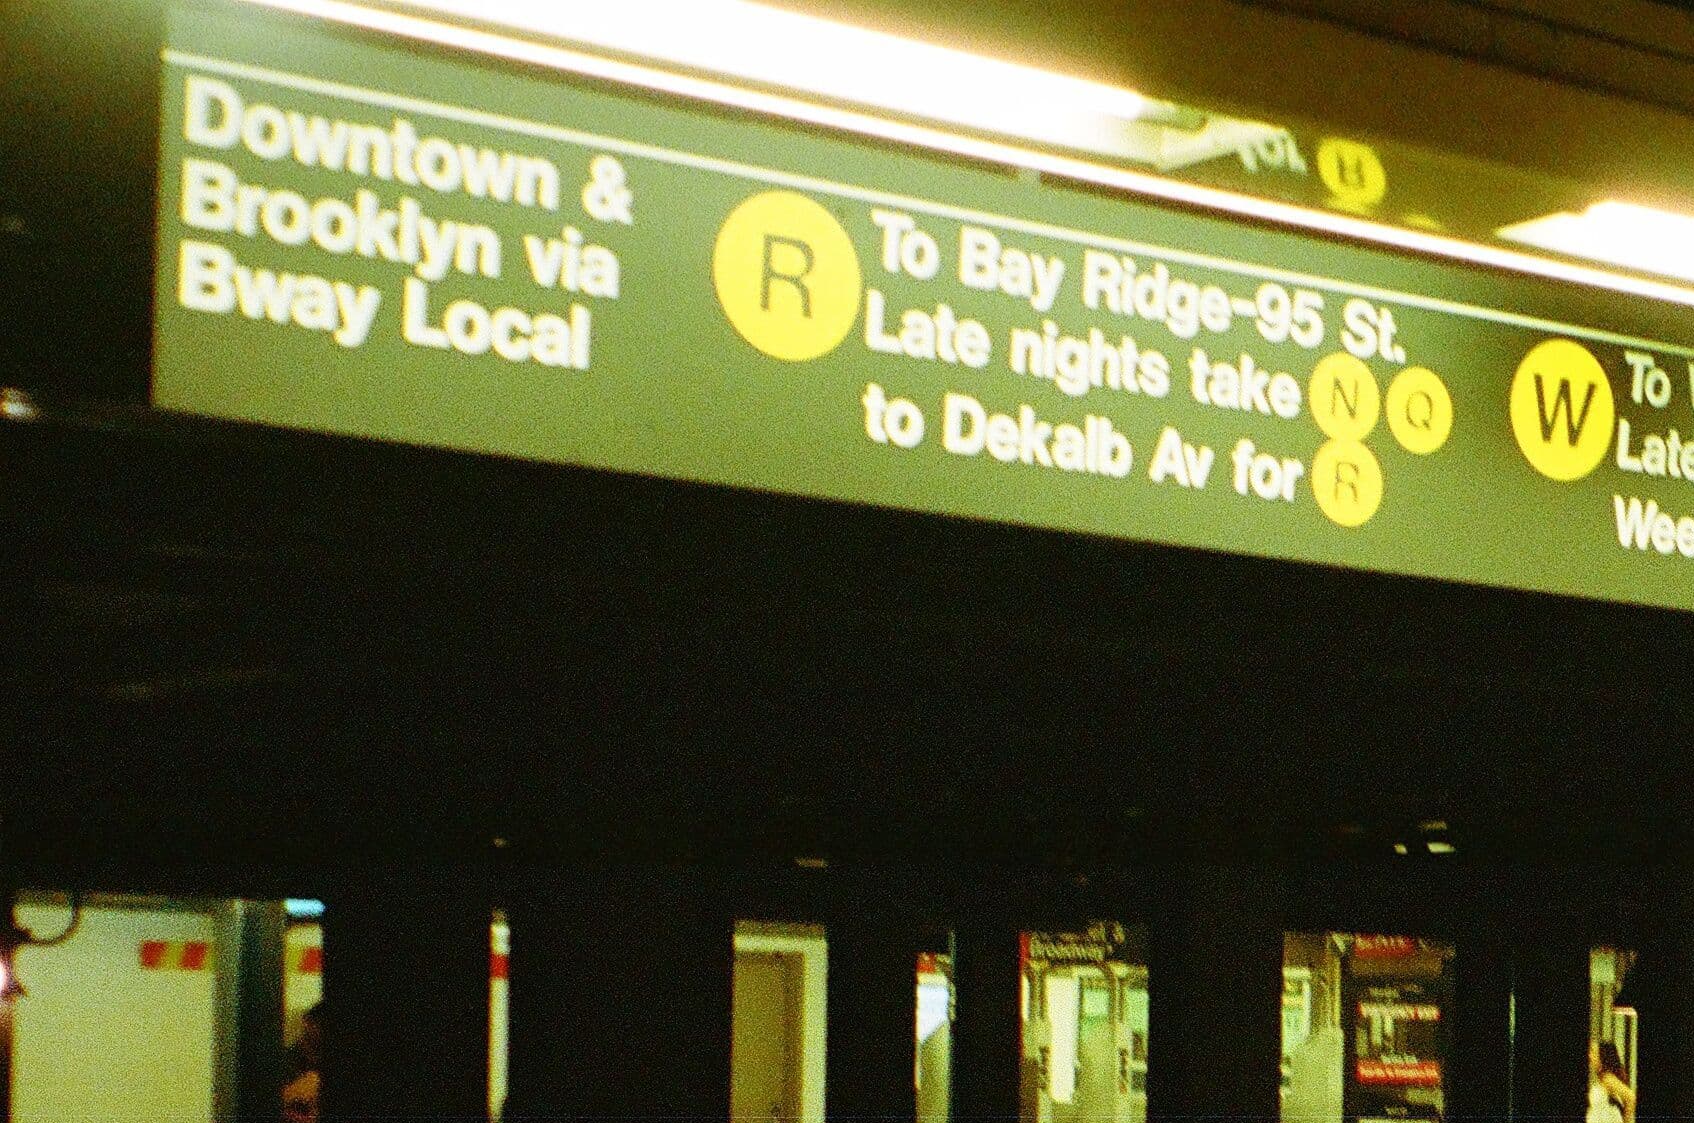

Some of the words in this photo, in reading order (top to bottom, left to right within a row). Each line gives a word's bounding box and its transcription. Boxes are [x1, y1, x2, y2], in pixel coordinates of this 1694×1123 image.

[185, 77, 560, 209] Downtown
[582, 156, 634, 225] &
[180, 159, 500, 279] Brooklyn
[525, 226, 620, 298] via
[872, 209, 940, 279] To
[958, 227, 1063, 312] Bay
[1083, 250, 1326, 347] Ridge-95
[1341, 301, 1407, 364] St.
[179, 241, 380, 349] Bway
[402, 279, 592, 370] Local
[866, 291, 991, 368] Late
[1010, 318, 1170, 398] nights
[1189, 348, 1301, 418] take
[863, 383, 925, 448] to
[943, 394, 1133, 479] Dekalb
[1150, 426, 1214, 489] Av
[1233, 439, 1304, 503] for
[1625, 352, 1672, 410] To
